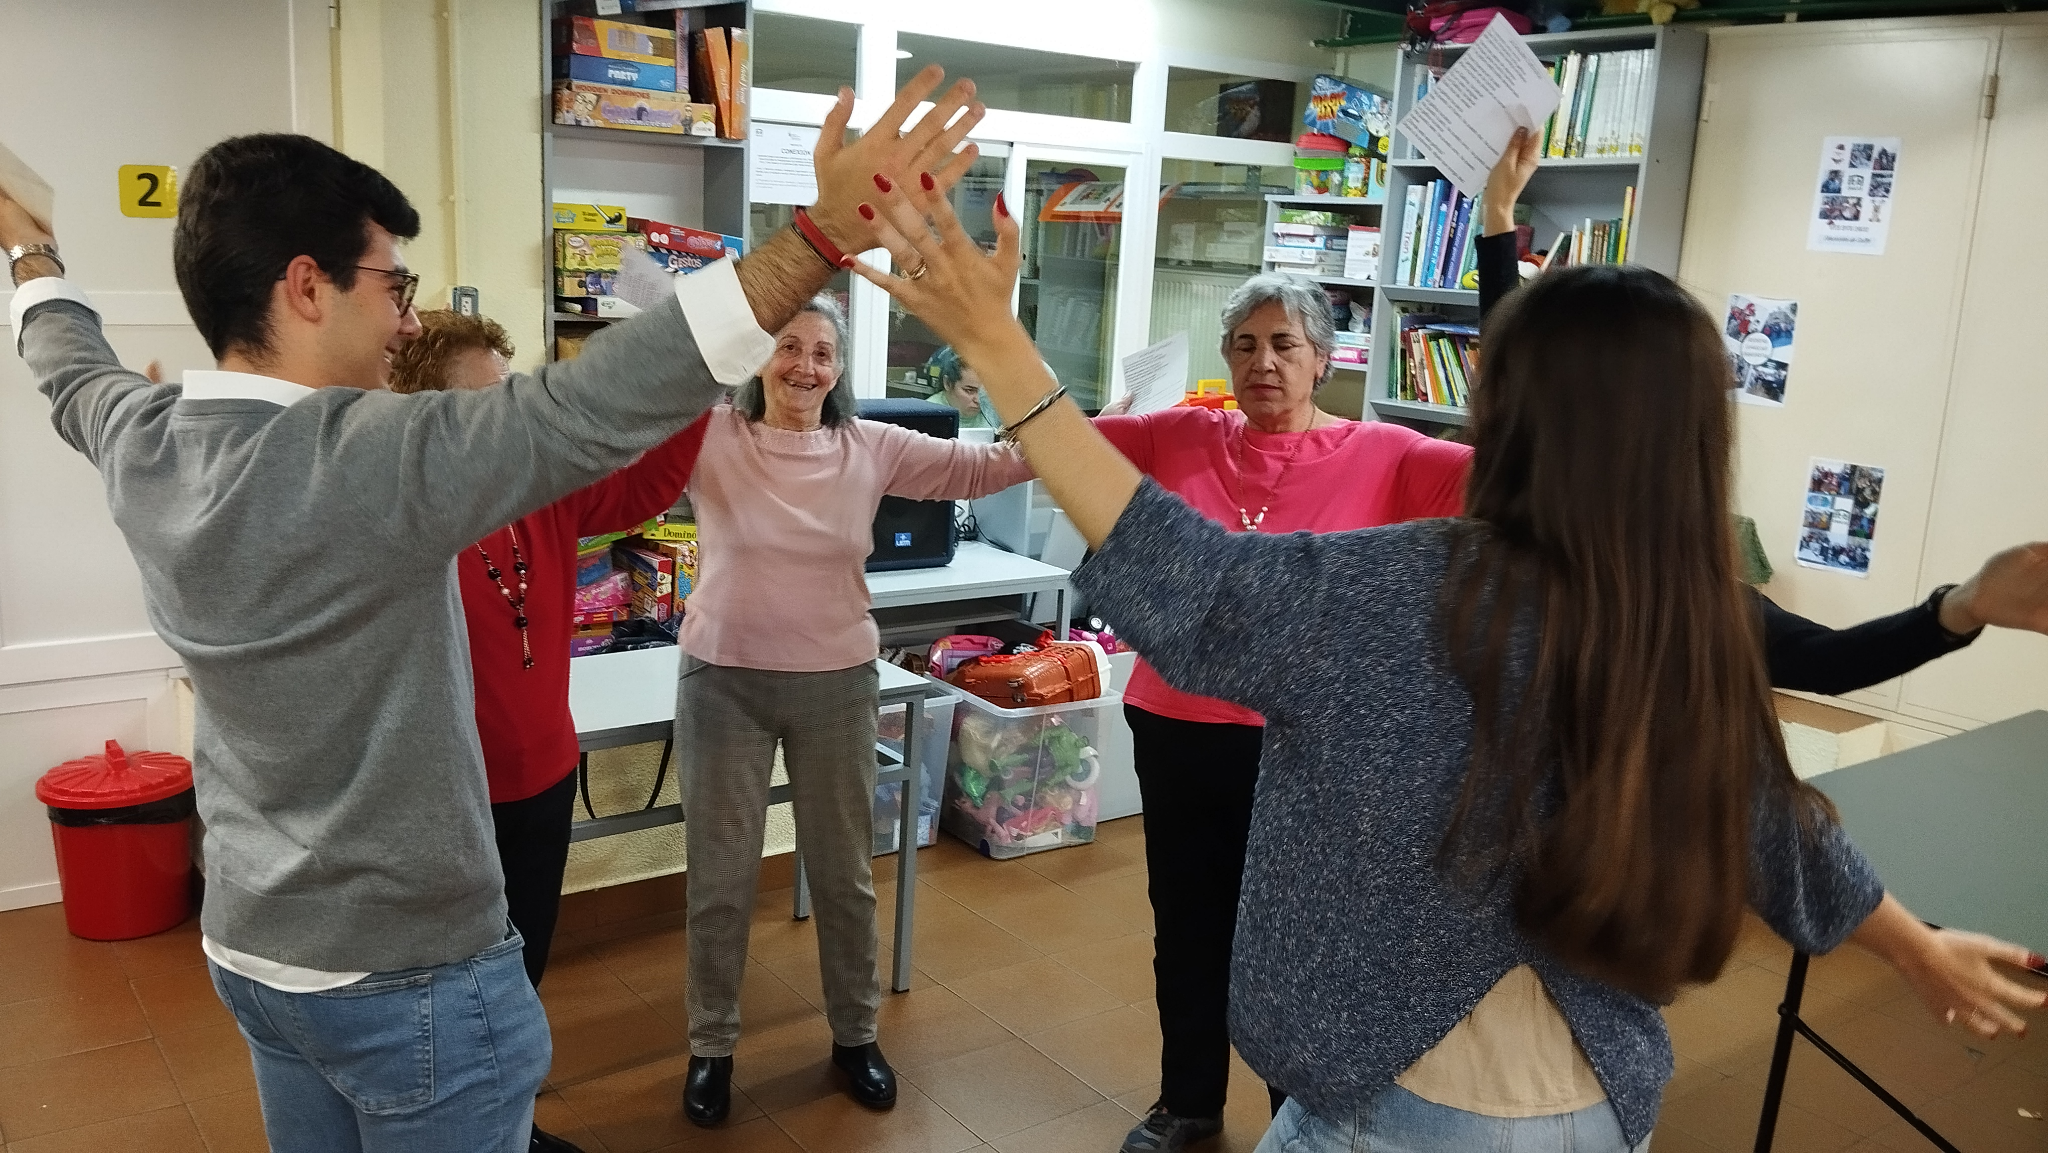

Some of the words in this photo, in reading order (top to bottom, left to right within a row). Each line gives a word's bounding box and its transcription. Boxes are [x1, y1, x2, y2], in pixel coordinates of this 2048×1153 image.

[607, 69, 638, 82] PARTY
[137, 172, 162, 207] 2
[663, 527, 697, 539] Dominó
